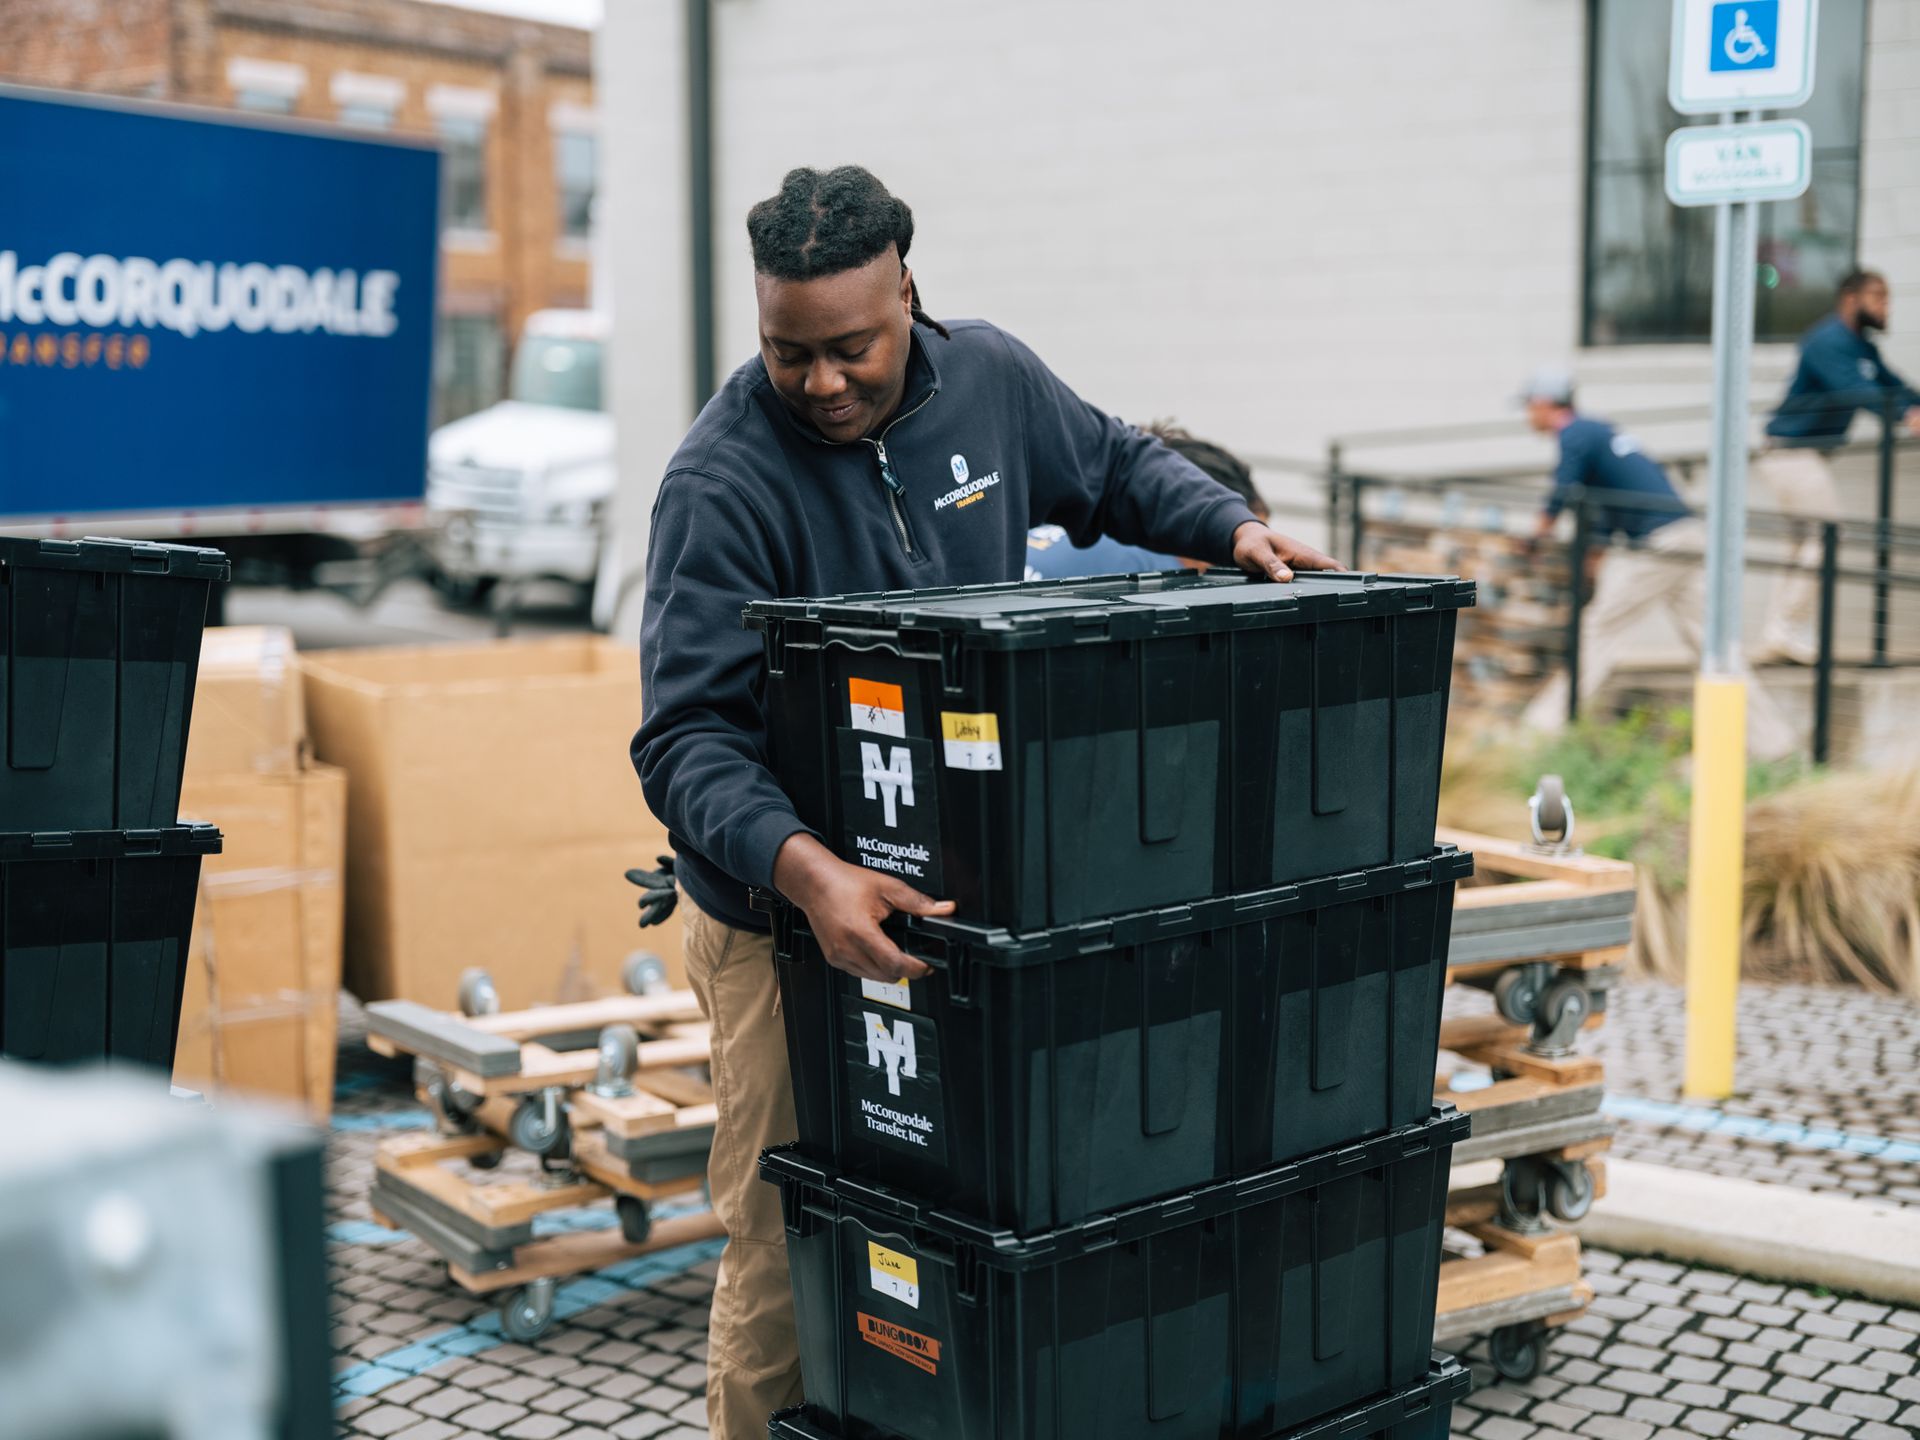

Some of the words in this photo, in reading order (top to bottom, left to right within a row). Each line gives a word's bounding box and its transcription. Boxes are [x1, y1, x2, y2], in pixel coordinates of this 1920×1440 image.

[934, 471, 1000, 511] McCORQUODALE
[856, 836, 930, 862] McCorquodale
[905, 860, 924, 877] Inc.
[861, 1099, 933, 1133] McCorquodale
[908, 1130, 928, 1146] Inc.
[867, 1318, 929, 1353] BUNGOBOX
